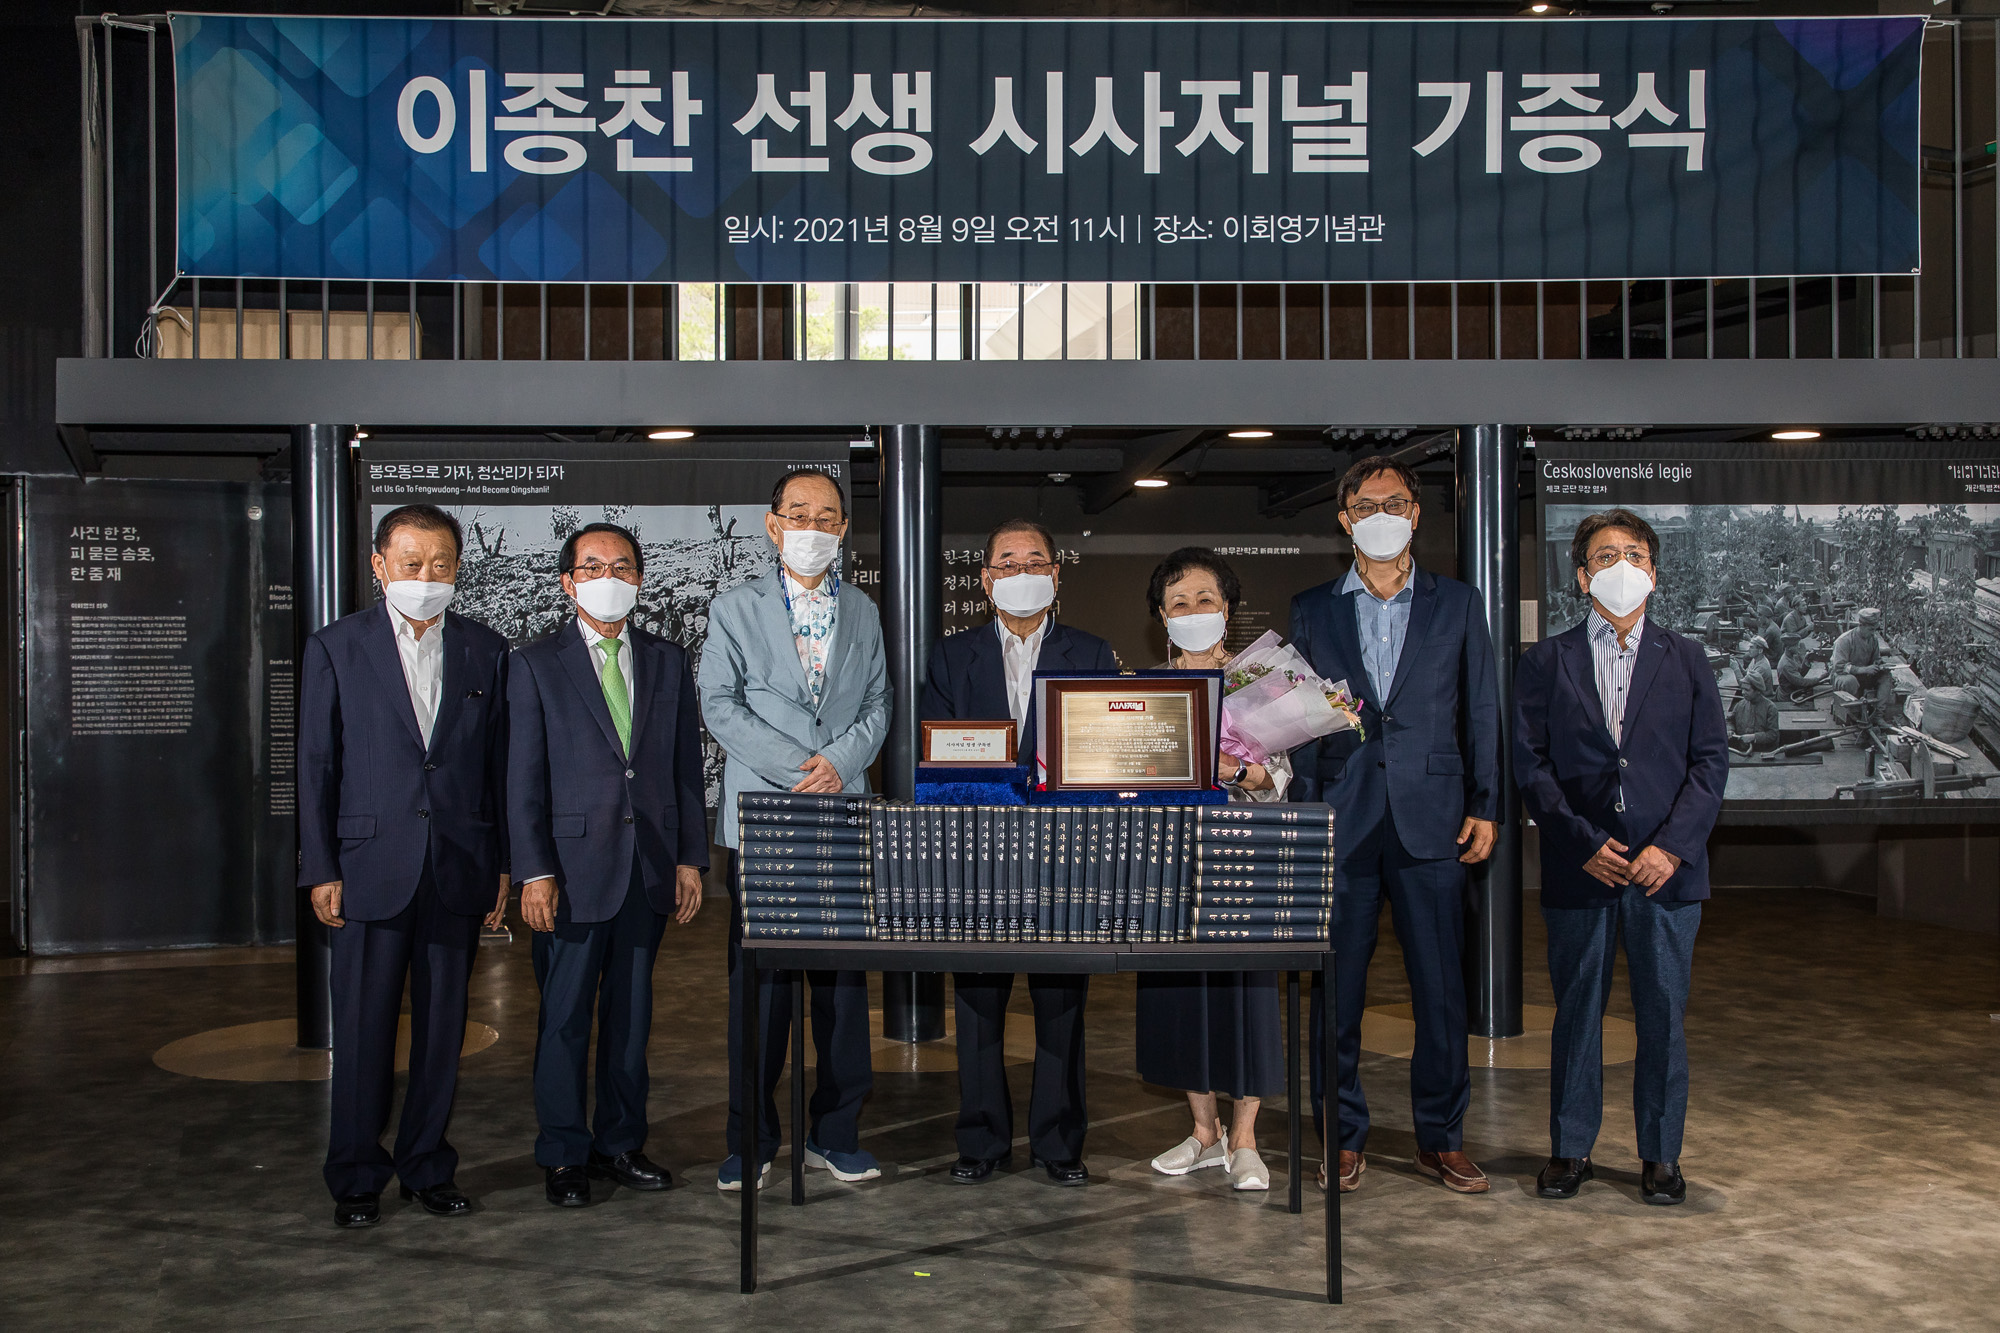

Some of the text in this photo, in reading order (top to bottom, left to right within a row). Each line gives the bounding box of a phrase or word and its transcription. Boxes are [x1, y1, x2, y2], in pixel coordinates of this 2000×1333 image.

[397, 69, 1706, 175] 이종찬 선생 시사저널 기증식
[724, 214, 1386, 243] 일시: 2021년 8월 9일 오전 11시 장소: 이회영기념관
[369, 464, 565, 482] 봉오동으로 가자, 청산리가 되자
[1543, 460, 1693, 483] Československé legie
[371, 485, 383, 493] Let
[384, 485, 394, 493] Us
[395, 485, 405, 493] Go
[406, 485, 414, 493] To
[415, 485, 460, 495] Fengwudong
[466, 486, 481, 494] And
[482, 486, 510, 494] Become
[510, 485, 550, 495] Qingshanli!
[1562, 484, 1577, 493] 군단
[1592, 484, 1608, 493] 열차
[70, 526, 140, 542] 사진 한 장,
[70, 546, 155, 562] 피 묻은 솜옷,
[942, 549, 985, 566] 한국의
[70, 566, 121, 581] 한 줌 재
[943, 600, 995, 616] 더 위대
[1109, 702, 1144, 711] 시사저널
